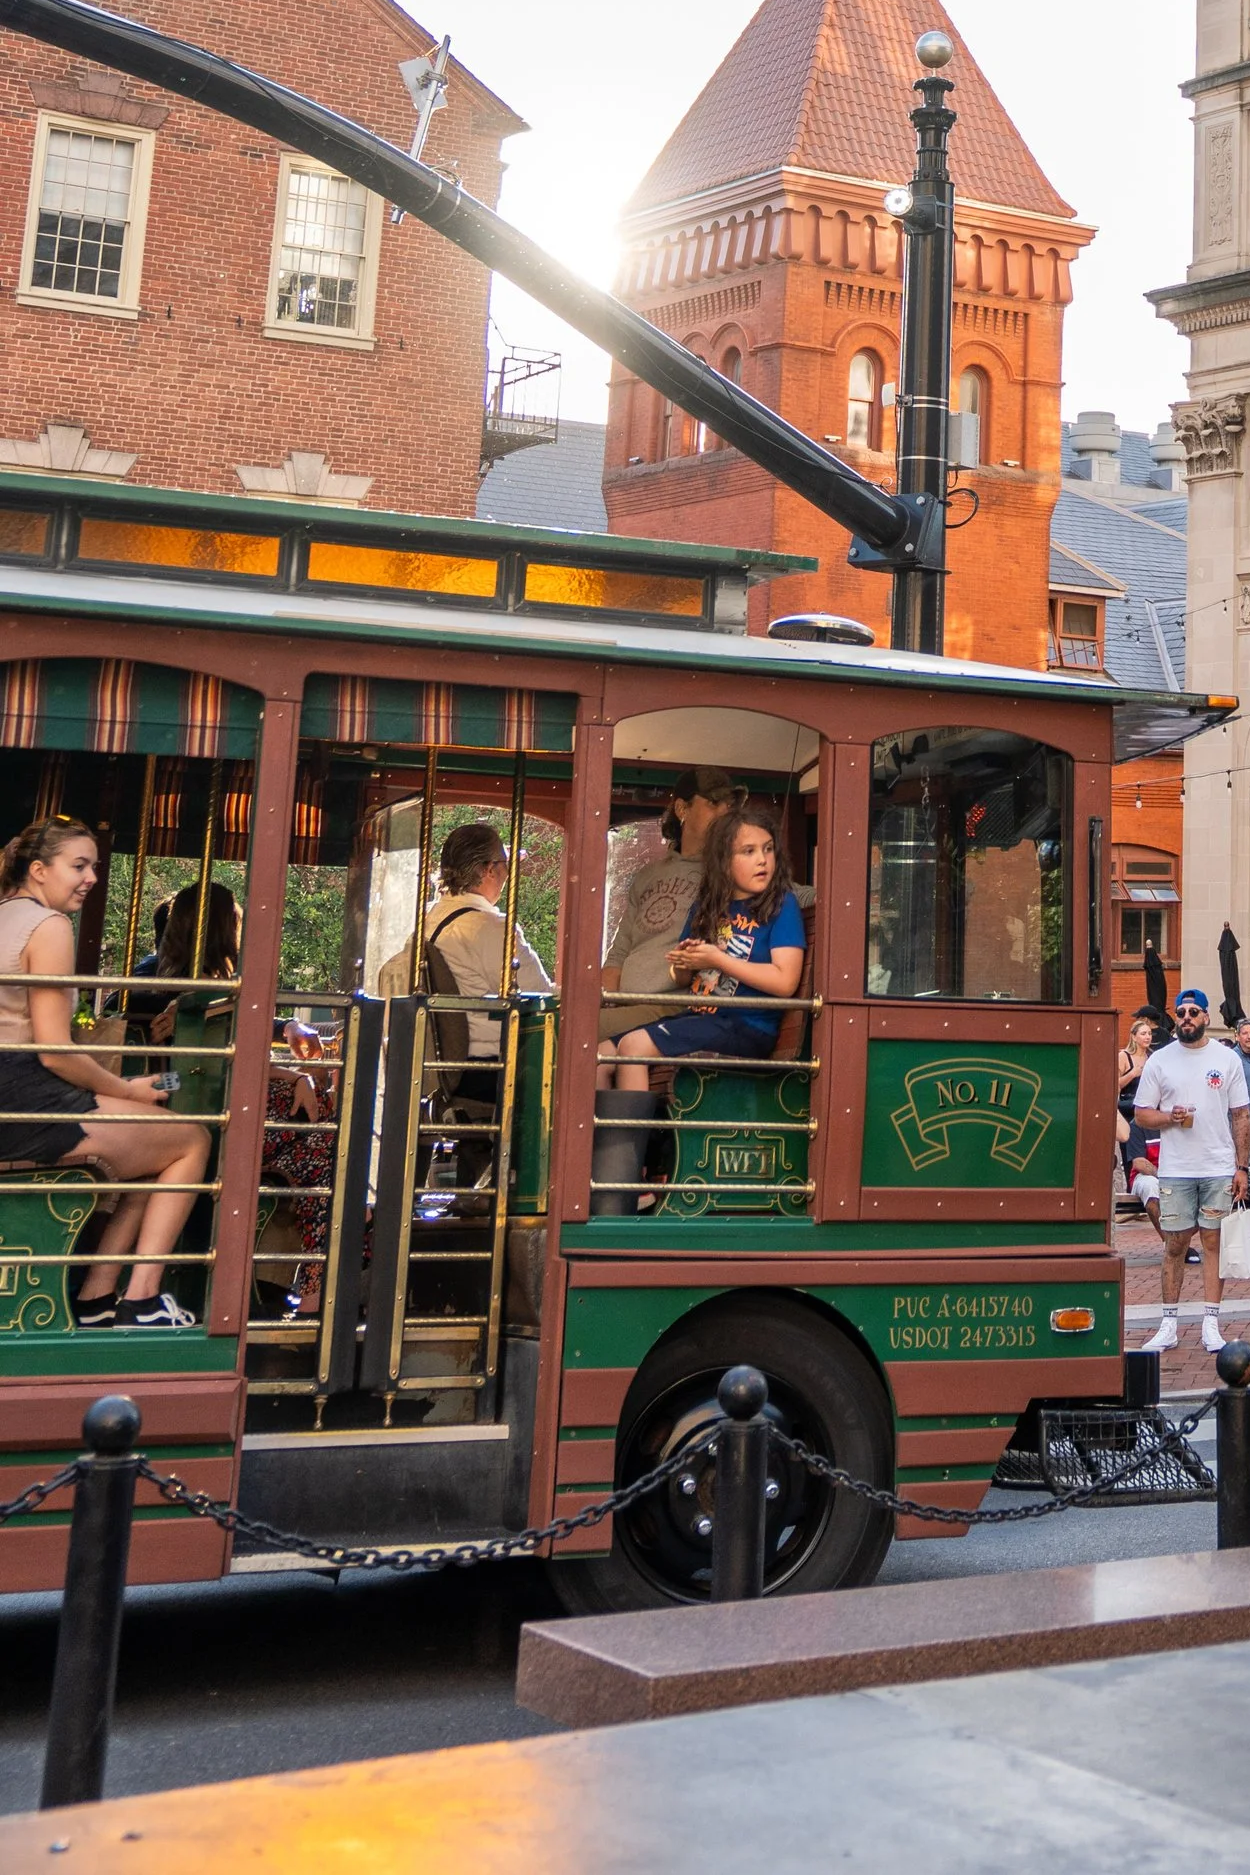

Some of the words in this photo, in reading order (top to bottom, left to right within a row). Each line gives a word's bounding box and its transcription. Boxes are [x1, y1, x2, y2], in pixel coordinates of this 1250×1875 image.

[988, 1079, 1012, 1107] 11
[892, 1296, 930, 1319] PUC
[889, 1326, 952, 1349] USDOT
[960, 1325, 1036, 1348] 2473315
